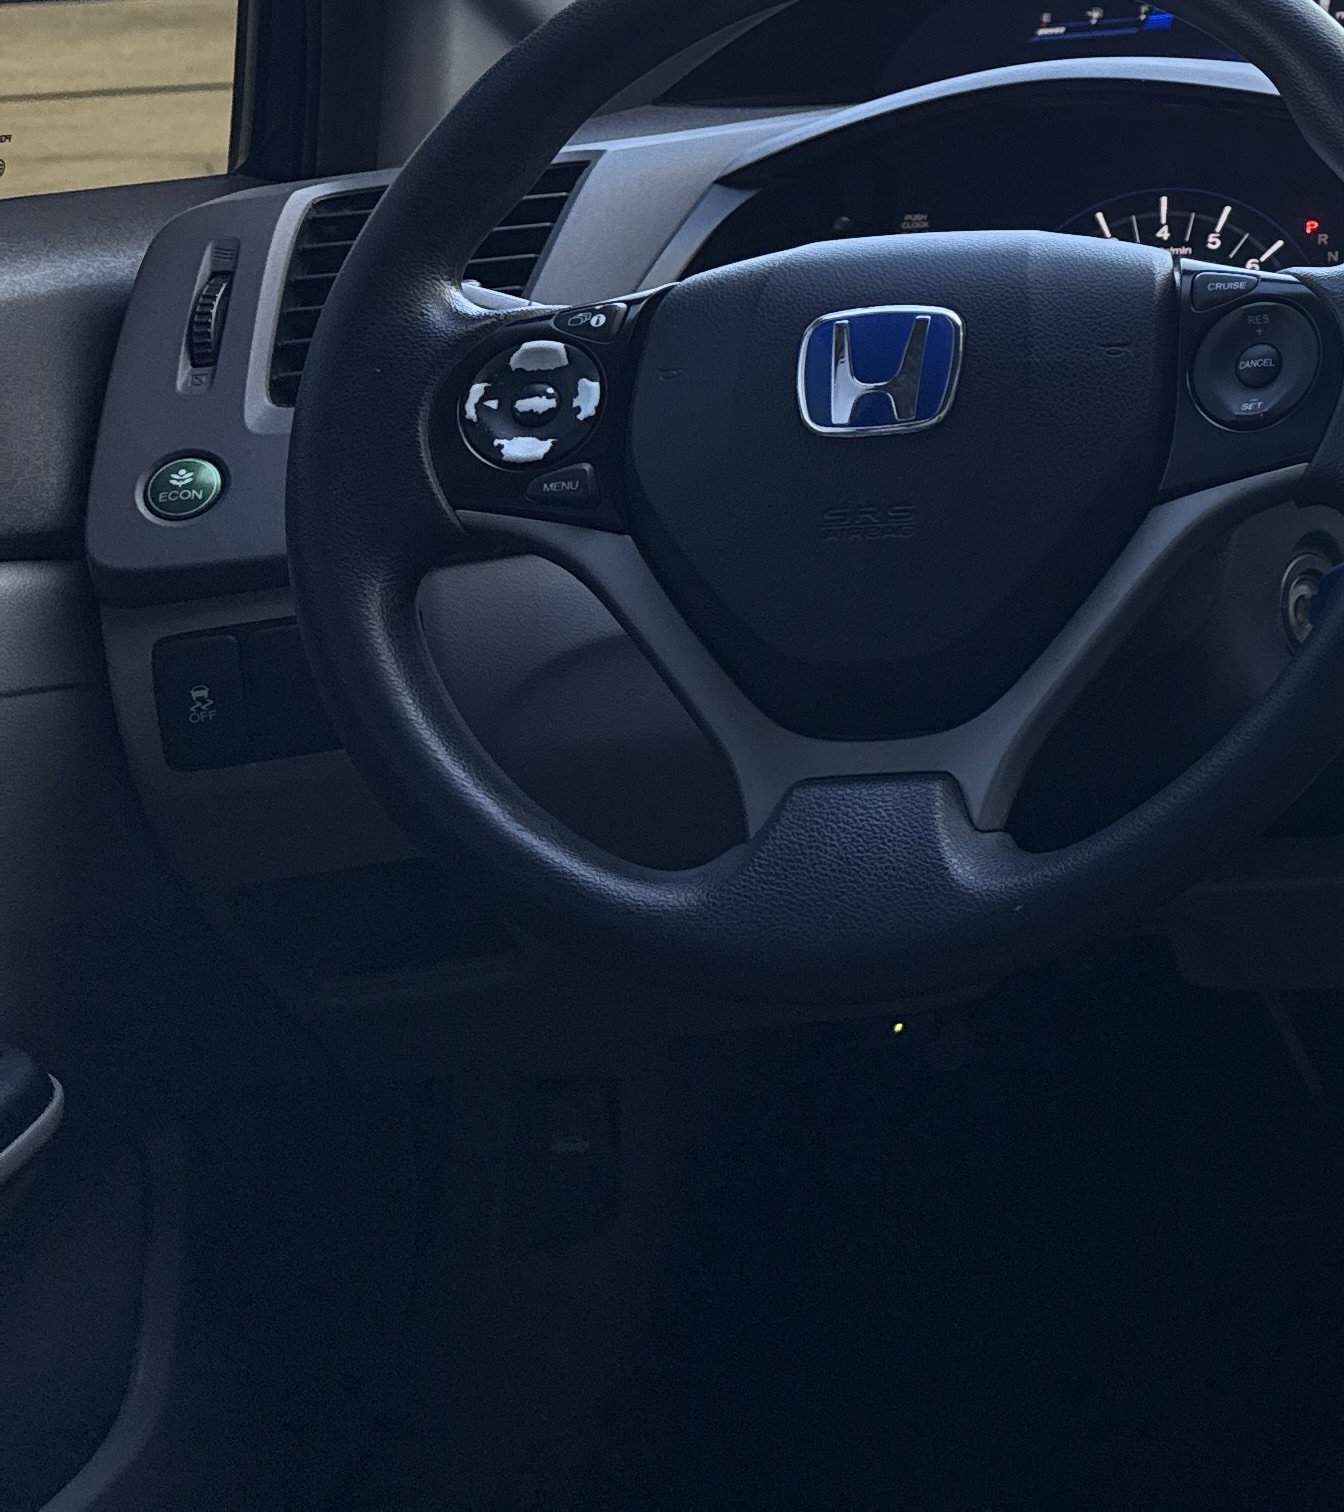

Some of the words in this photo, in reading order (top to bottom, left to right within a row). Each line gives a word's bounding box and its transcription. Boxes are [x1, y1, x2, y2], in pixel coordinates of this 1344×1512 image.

[1154, 223, 1171, 242] 4
[1304, 218, 1320, 235] P
[1206, 232, 1222, 250] 5
[1317, 233, 1330, 247] R
[1327, 250, 1340, 263] N
[1206, 281, 1247, 292] CRUISE
[1247, 313, 1271, 326] RES
[1239, 358, 1276, 370] CANCEL
[542, 480, 579, 493] MENU
[157, 488, 204, 504] ECON
[188, 709, 217, 725] OFF
